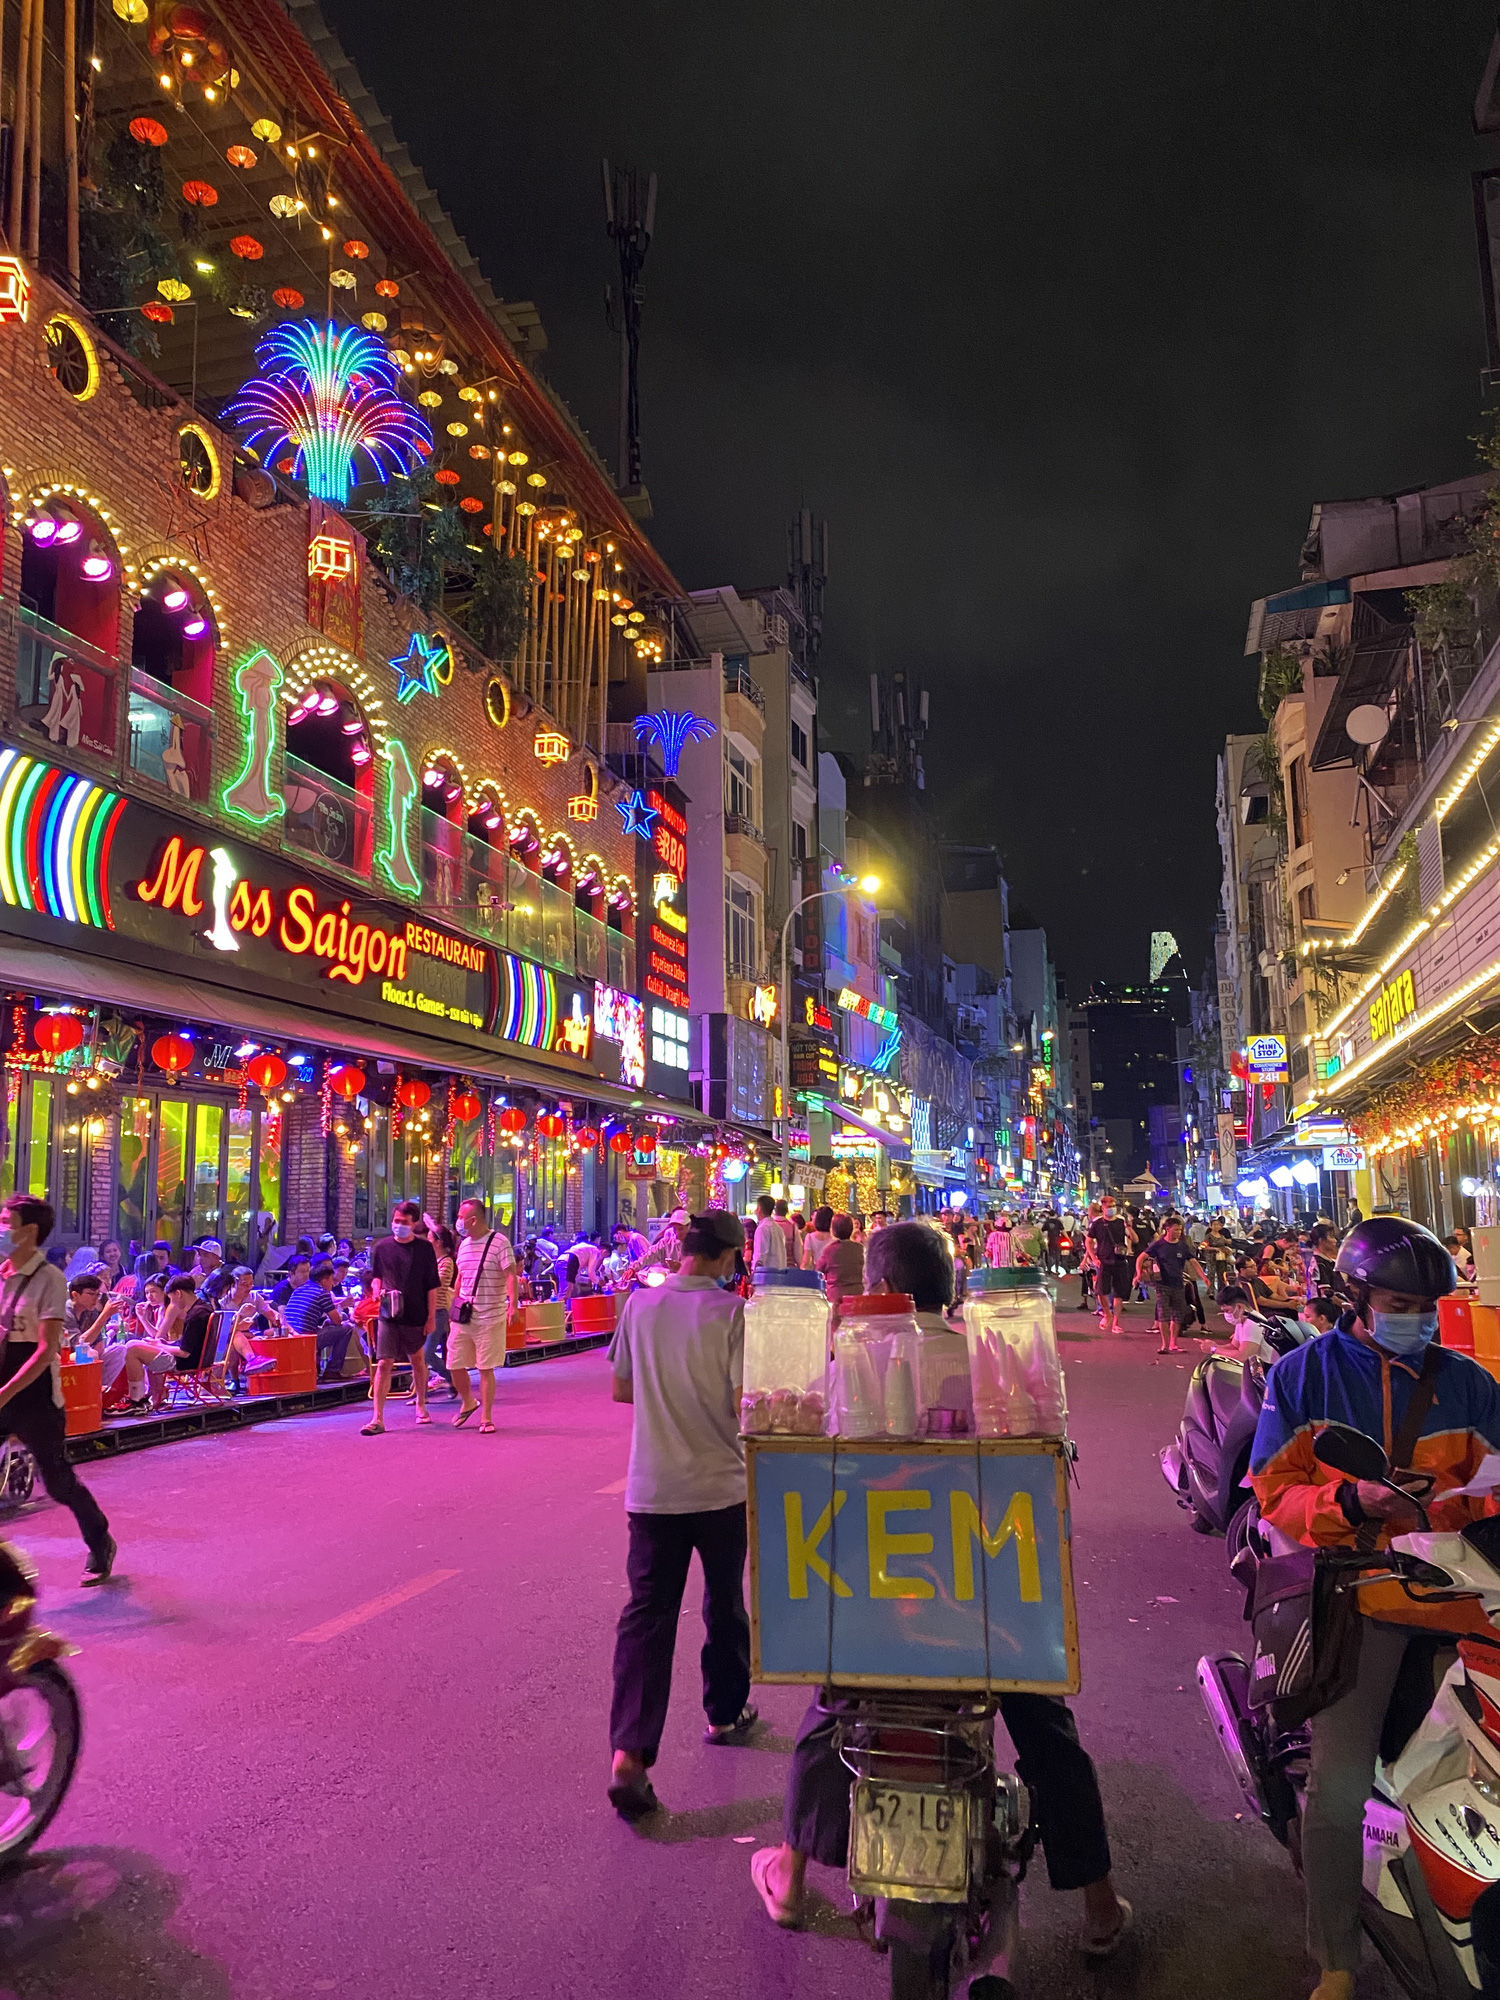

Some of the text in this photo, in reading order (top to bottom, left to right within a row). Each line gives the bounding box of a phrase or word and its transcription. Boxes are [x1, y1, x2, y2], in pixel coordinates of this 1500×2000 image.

[656, 826, 685, 883] BBQ
[280, 887, 407, 985] Saigon
[406, 922, 486, 973] RESTAURANT
[416, 993, 446, 1017] Games
[1369, 968, 1416, 1041] sahara
[1258, 1072, 1280, 1083] 24H
[799, 1175, 817, 1188] 148
[783, 1490, 1042, 1602] KEM
